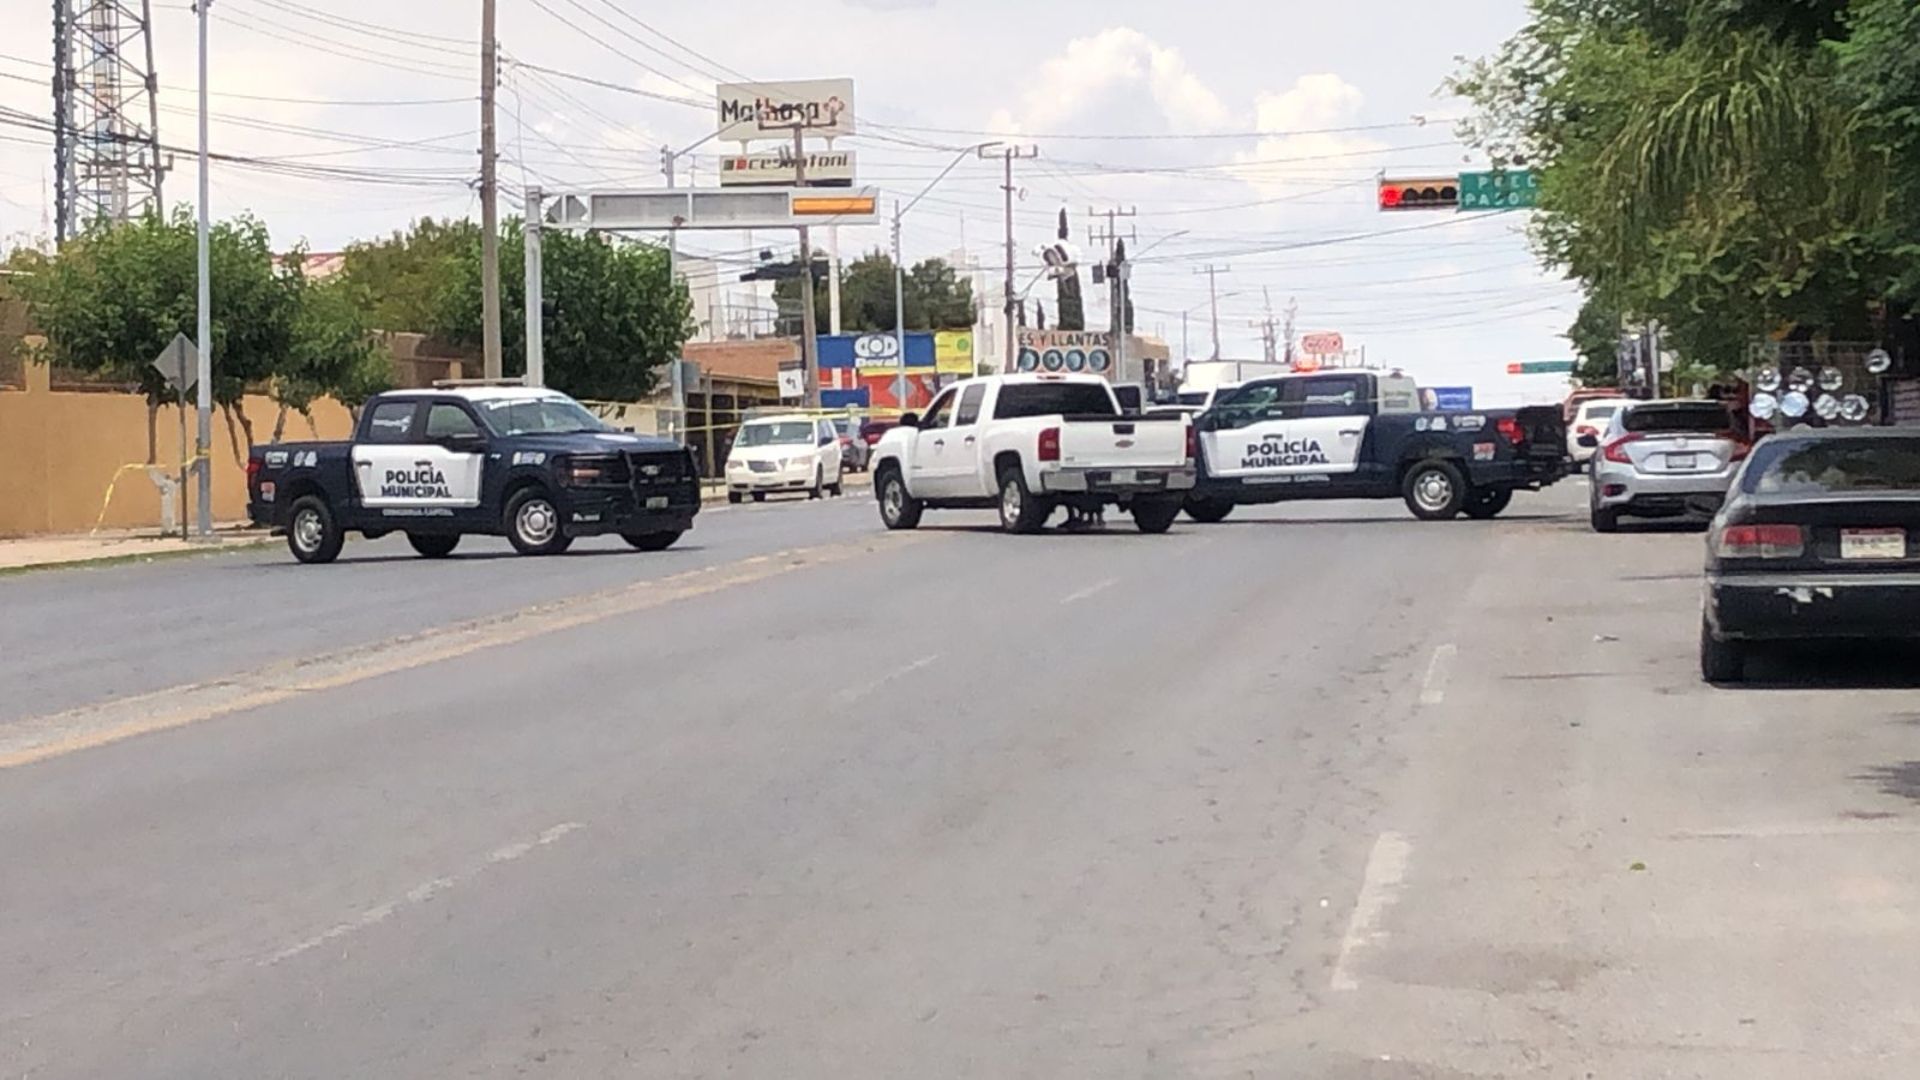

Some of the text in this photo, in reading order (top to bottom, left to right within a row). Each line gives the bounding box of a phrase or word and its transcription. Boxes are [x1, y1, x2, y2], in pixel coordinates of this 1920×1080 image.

[1051, 333, 1109, 346] LLANTAS
[1247, 437, 1321, 456] POLICÍA
[1241, 453, 1330, 468] MUNICIPAL
[386, 466, 445, 484] POLICÍA
[381, 485, 452, 498] MUNICIPAL
